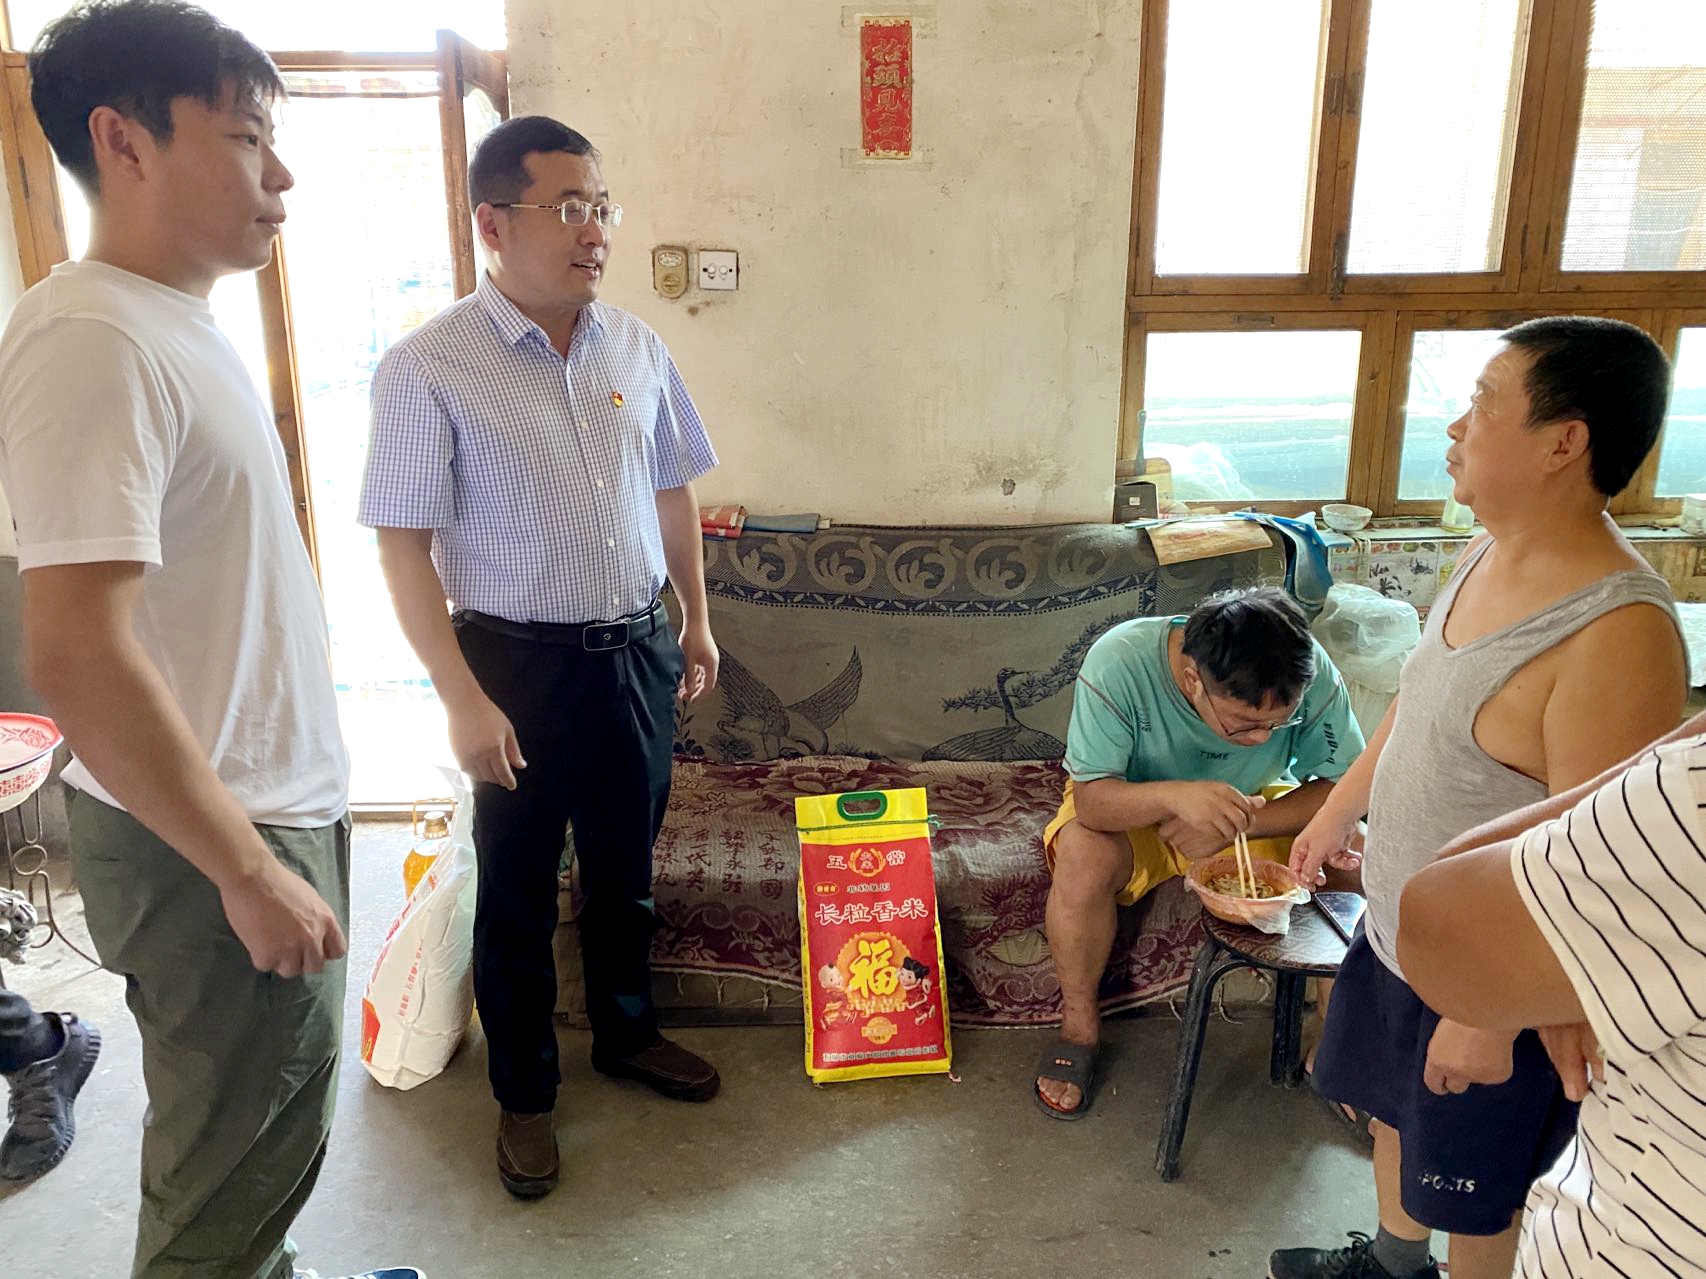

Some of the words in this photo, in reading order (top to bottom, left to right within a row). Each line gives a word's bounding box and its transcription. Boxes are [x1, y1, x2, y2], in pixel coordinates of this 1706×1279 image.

[827, 854, 848, 870] 五
[886, 849, 906, 867] 常
[814, 898, 929, 926] 长粒香米
[849, 939, 899, 998] 福
